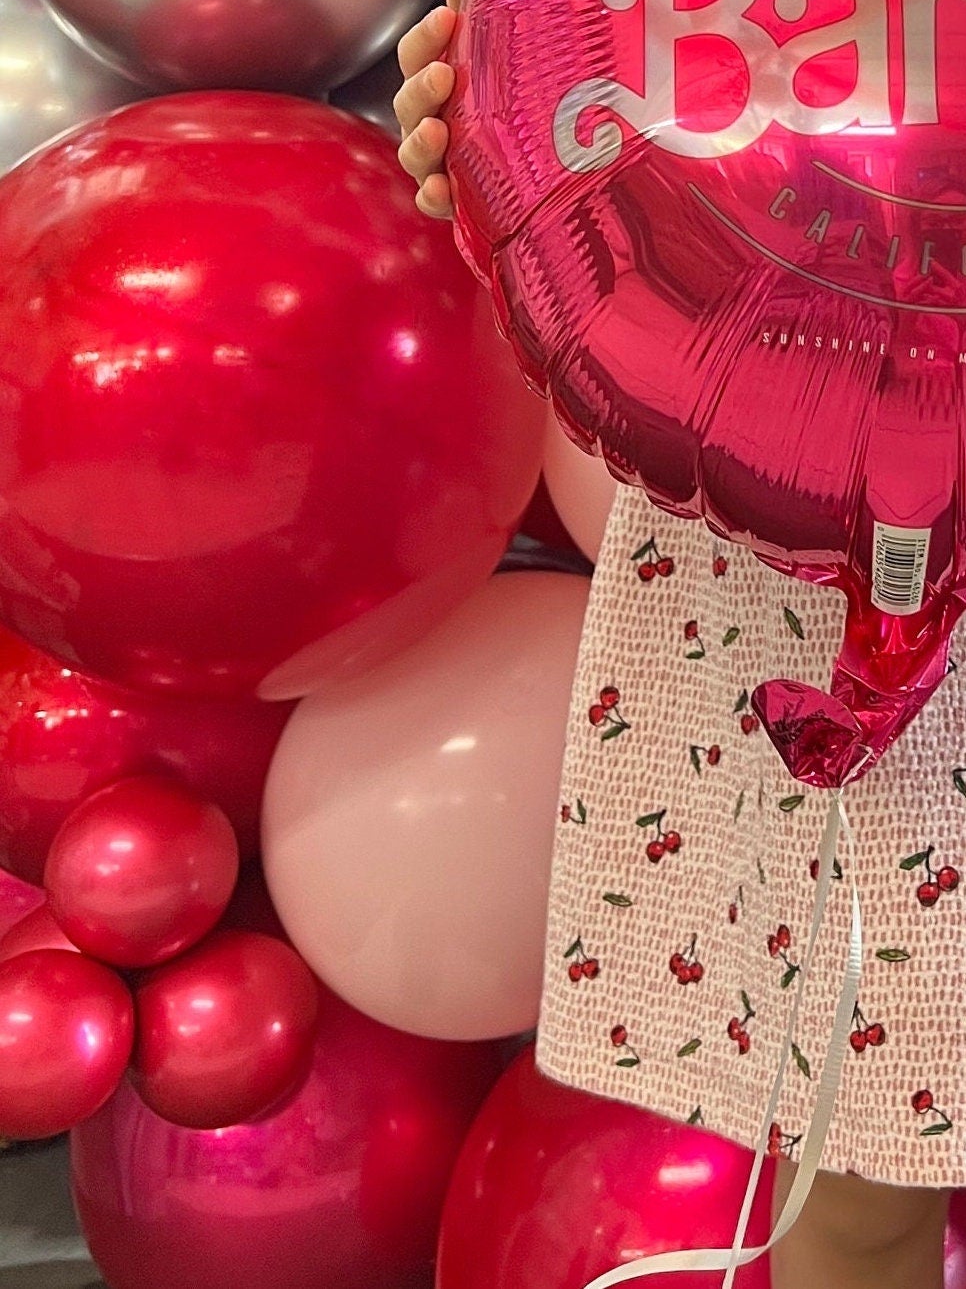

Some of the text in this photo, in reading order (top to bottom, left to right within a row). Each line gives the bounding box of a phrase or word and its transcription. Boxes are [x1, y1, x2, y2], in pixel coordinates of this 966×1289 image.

[762, 332, 886, 356] SUNSHINE
[910, 347, 935, 360] ON
[875, 539, 885, 566] 26635
[916, 538, 926, 559] ITEM
